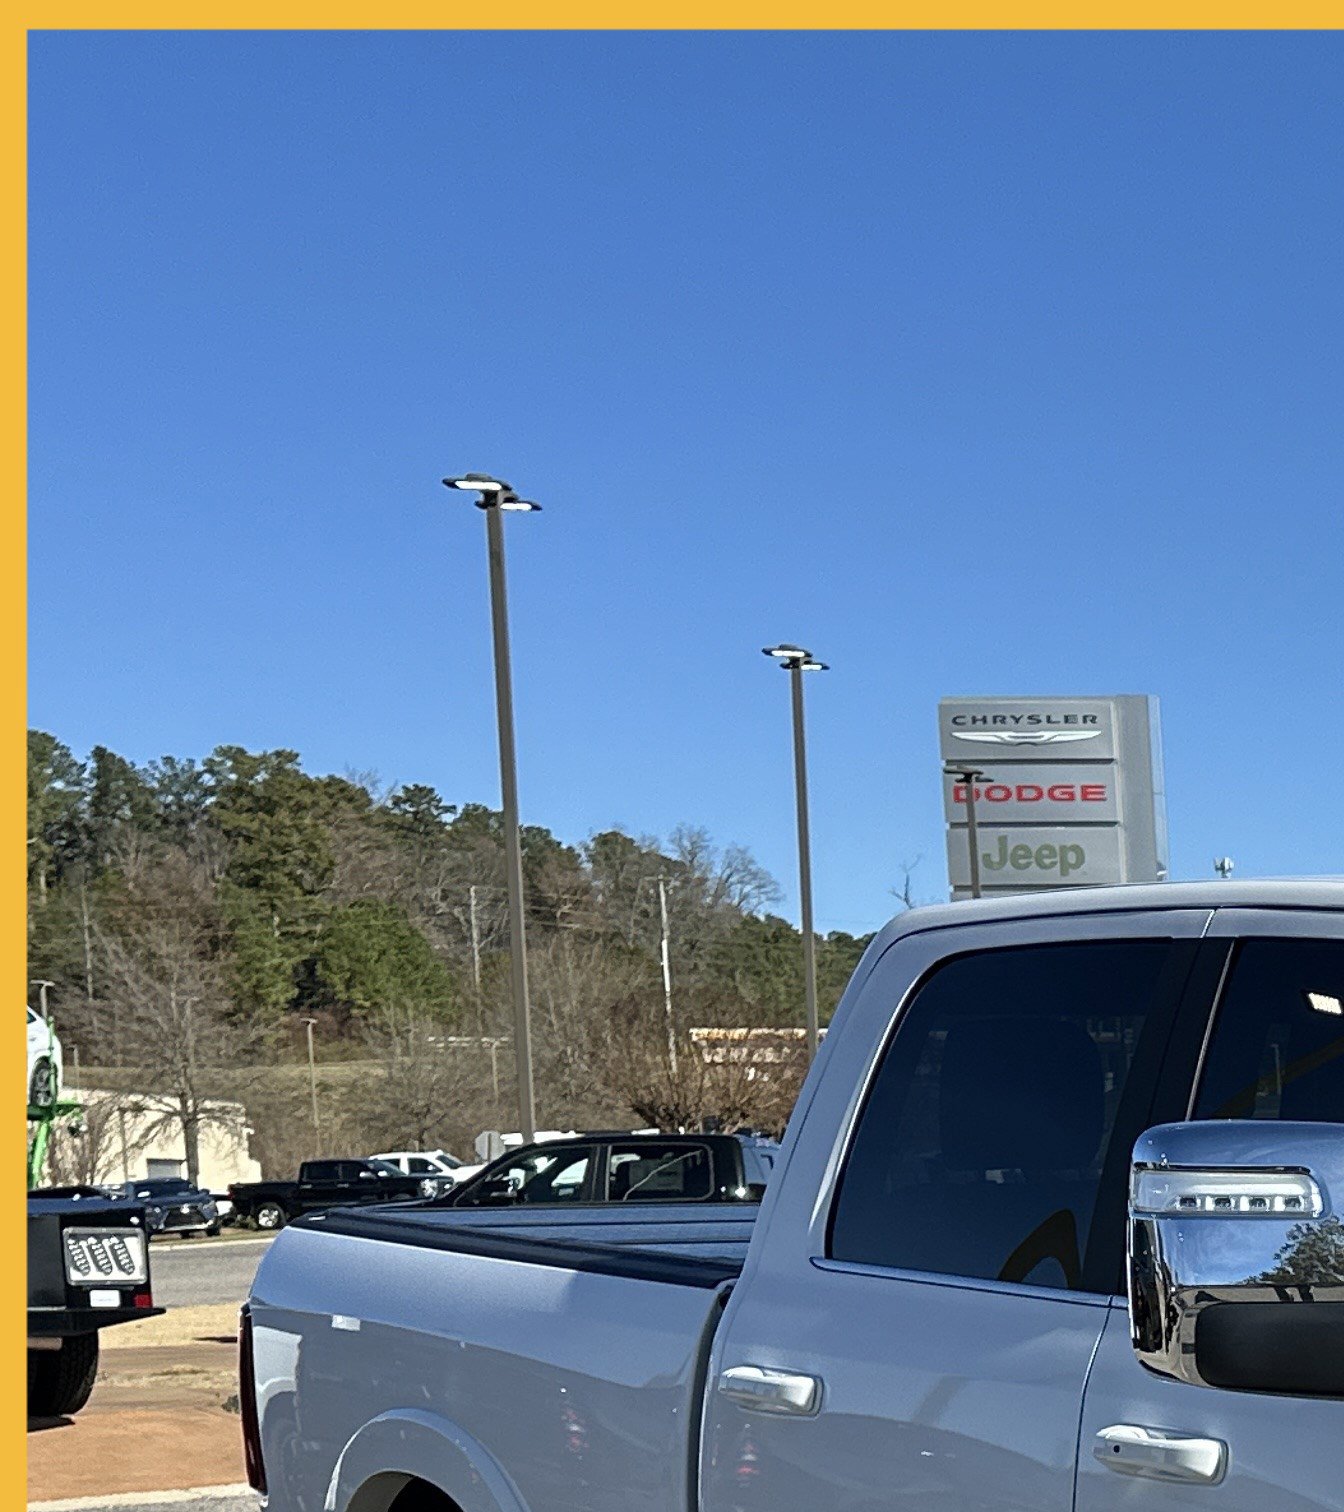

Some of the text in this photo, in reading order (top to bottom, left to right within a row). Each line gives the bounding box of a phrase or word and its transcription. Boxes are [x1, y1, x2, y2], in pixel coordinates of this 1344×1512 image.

[951, 714, 1098, 726] CHRYSLER
[952, 784, 1107, 803] DODGE
[982, 835, 1086, 877] Jeep
